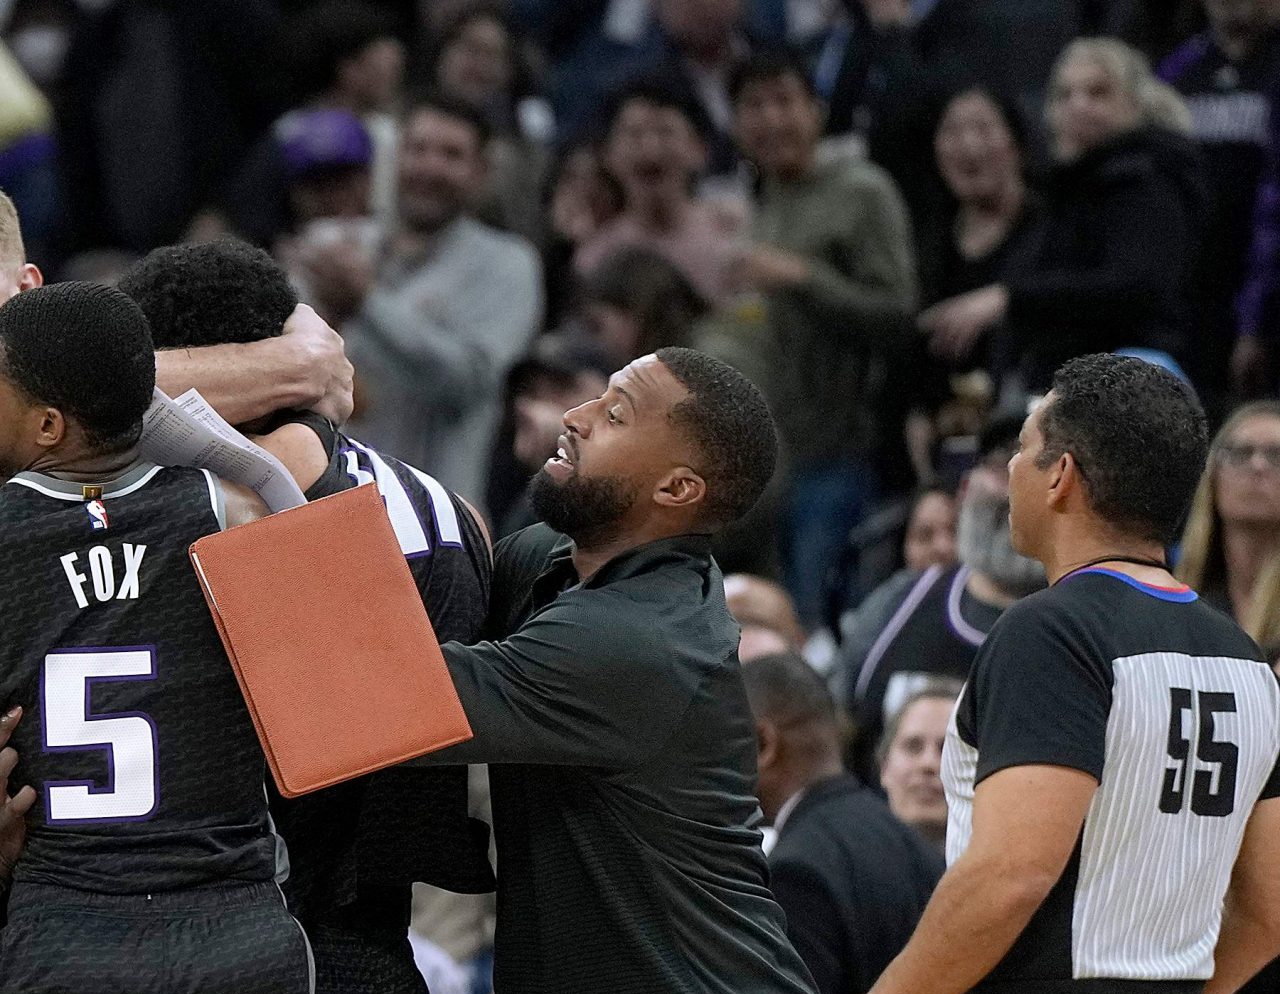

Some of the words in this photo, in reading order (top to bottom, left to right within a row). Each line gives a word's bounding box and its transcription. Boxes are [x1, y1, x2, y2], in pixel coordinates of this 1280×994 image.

[60, 542, 147, 609] FOX
[42, 648, 158, 822] 5
[1158, 686, 1240, 817] 55
